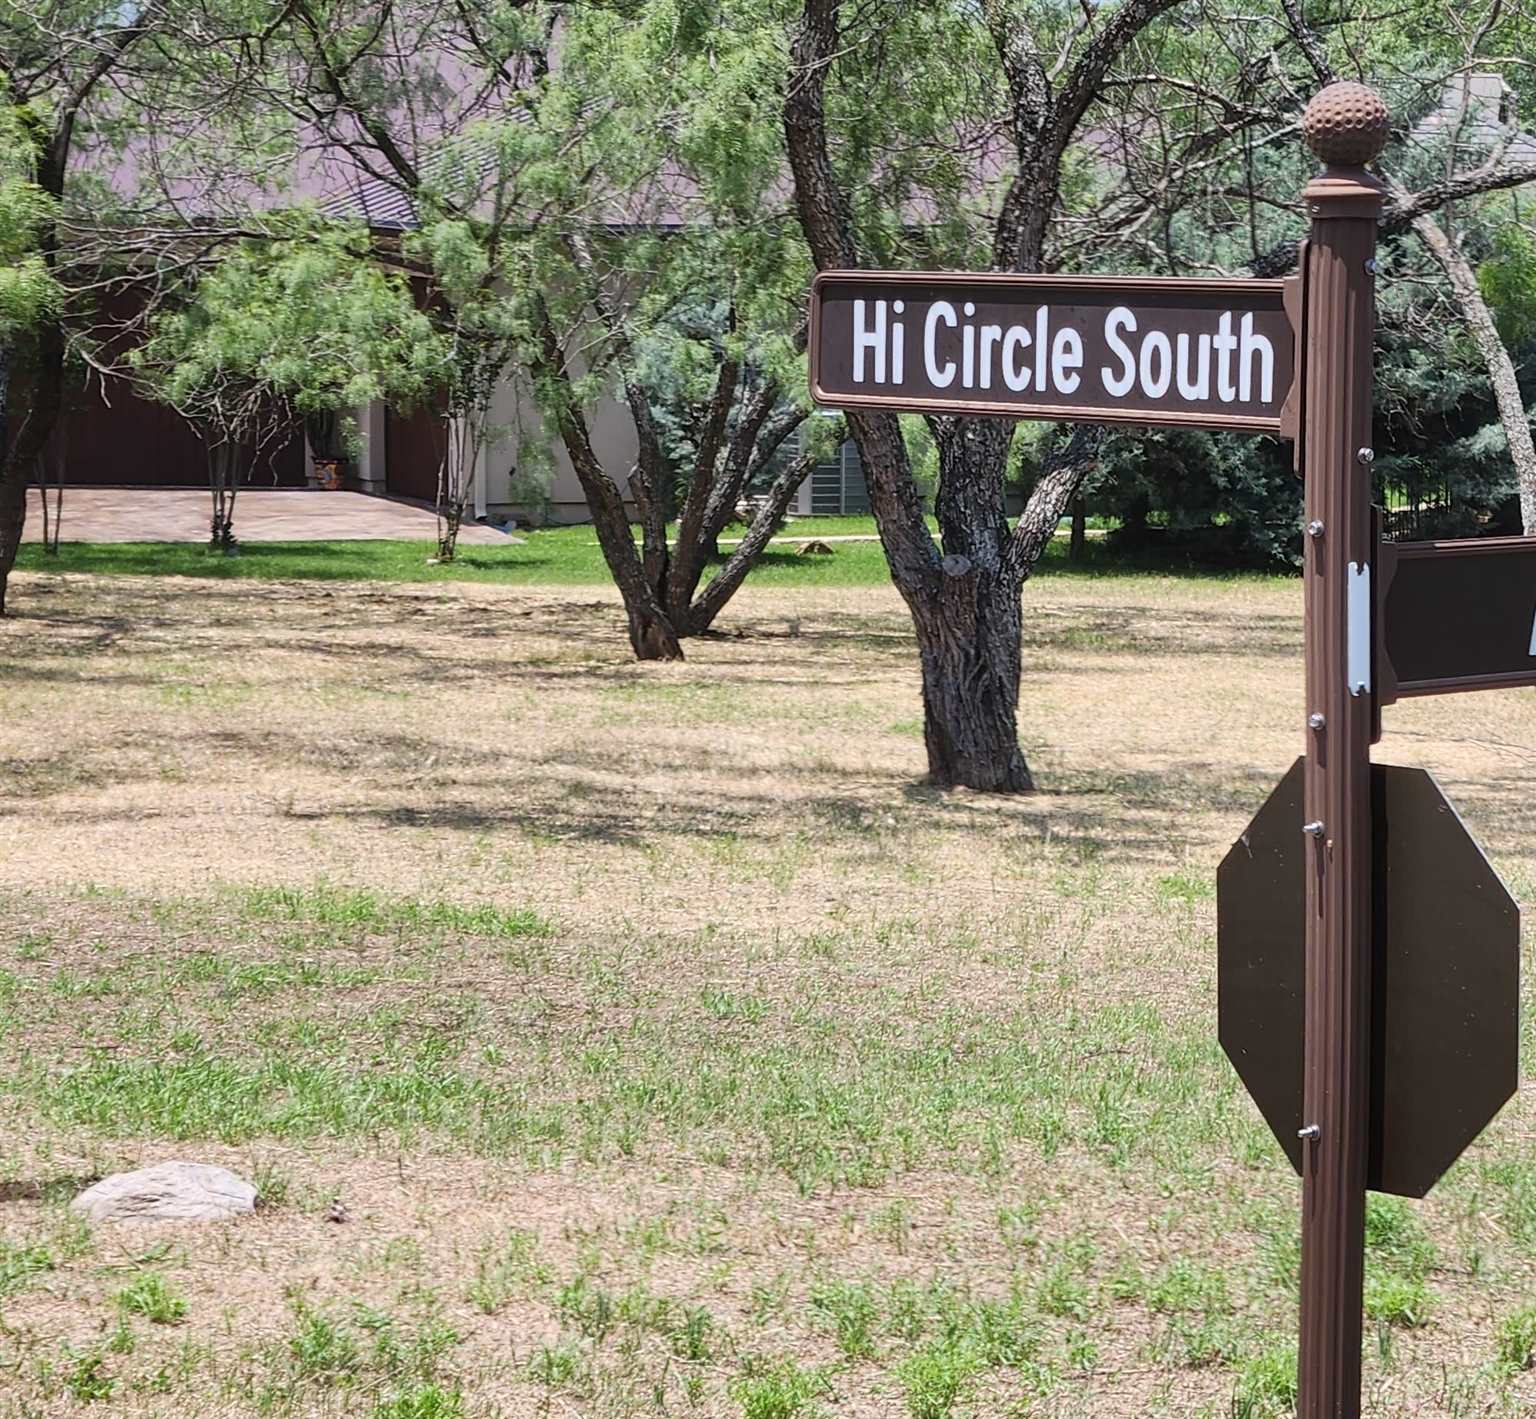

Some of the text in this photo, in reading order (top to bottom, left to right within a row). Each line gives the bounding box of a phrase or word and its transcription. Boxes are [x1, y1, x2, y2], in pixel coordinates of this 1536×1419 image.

[853, 299, 1274, 403] Hi Circle South
